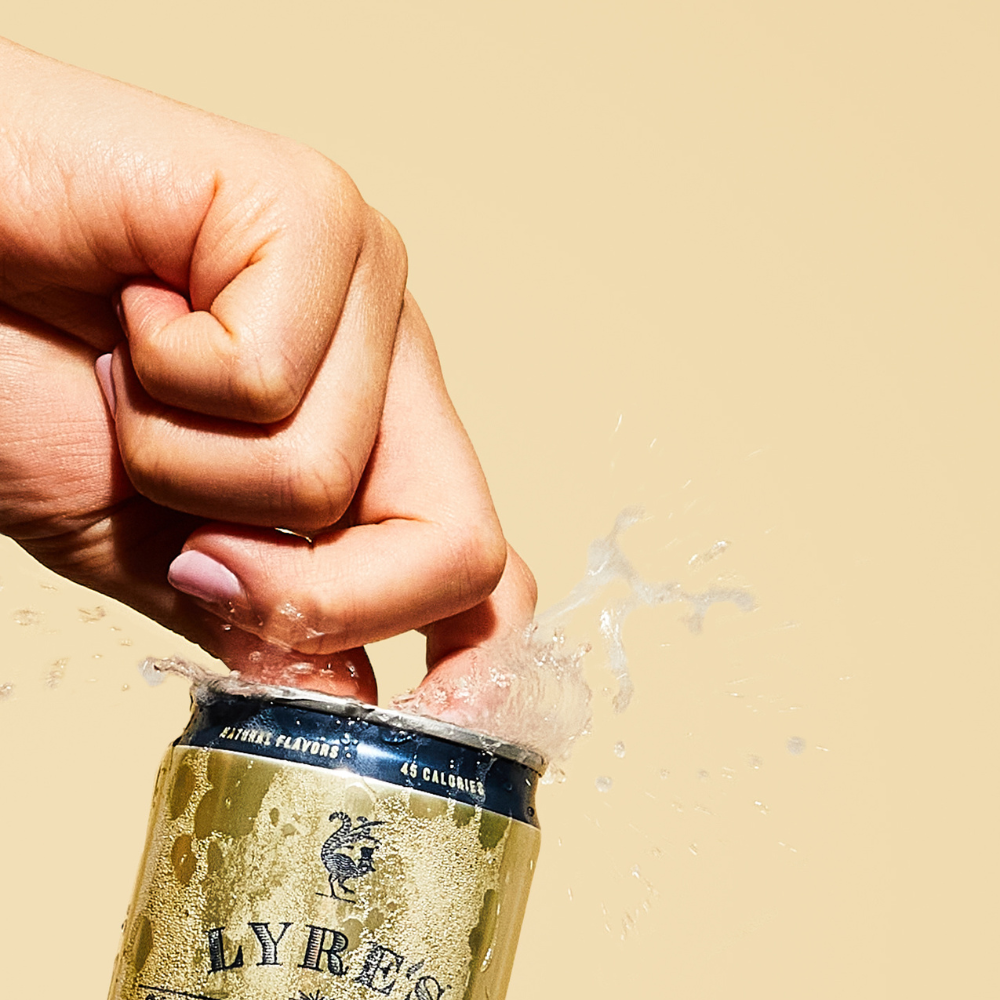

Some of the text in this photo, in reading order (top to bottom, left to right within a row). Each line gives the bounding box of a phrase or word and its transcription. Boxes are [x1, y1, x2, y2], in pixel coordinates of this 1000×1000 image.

[219, 726, 339, 759] NATURAL FLAVORS
[400, 761, 486, 796] 45 CALORIES
